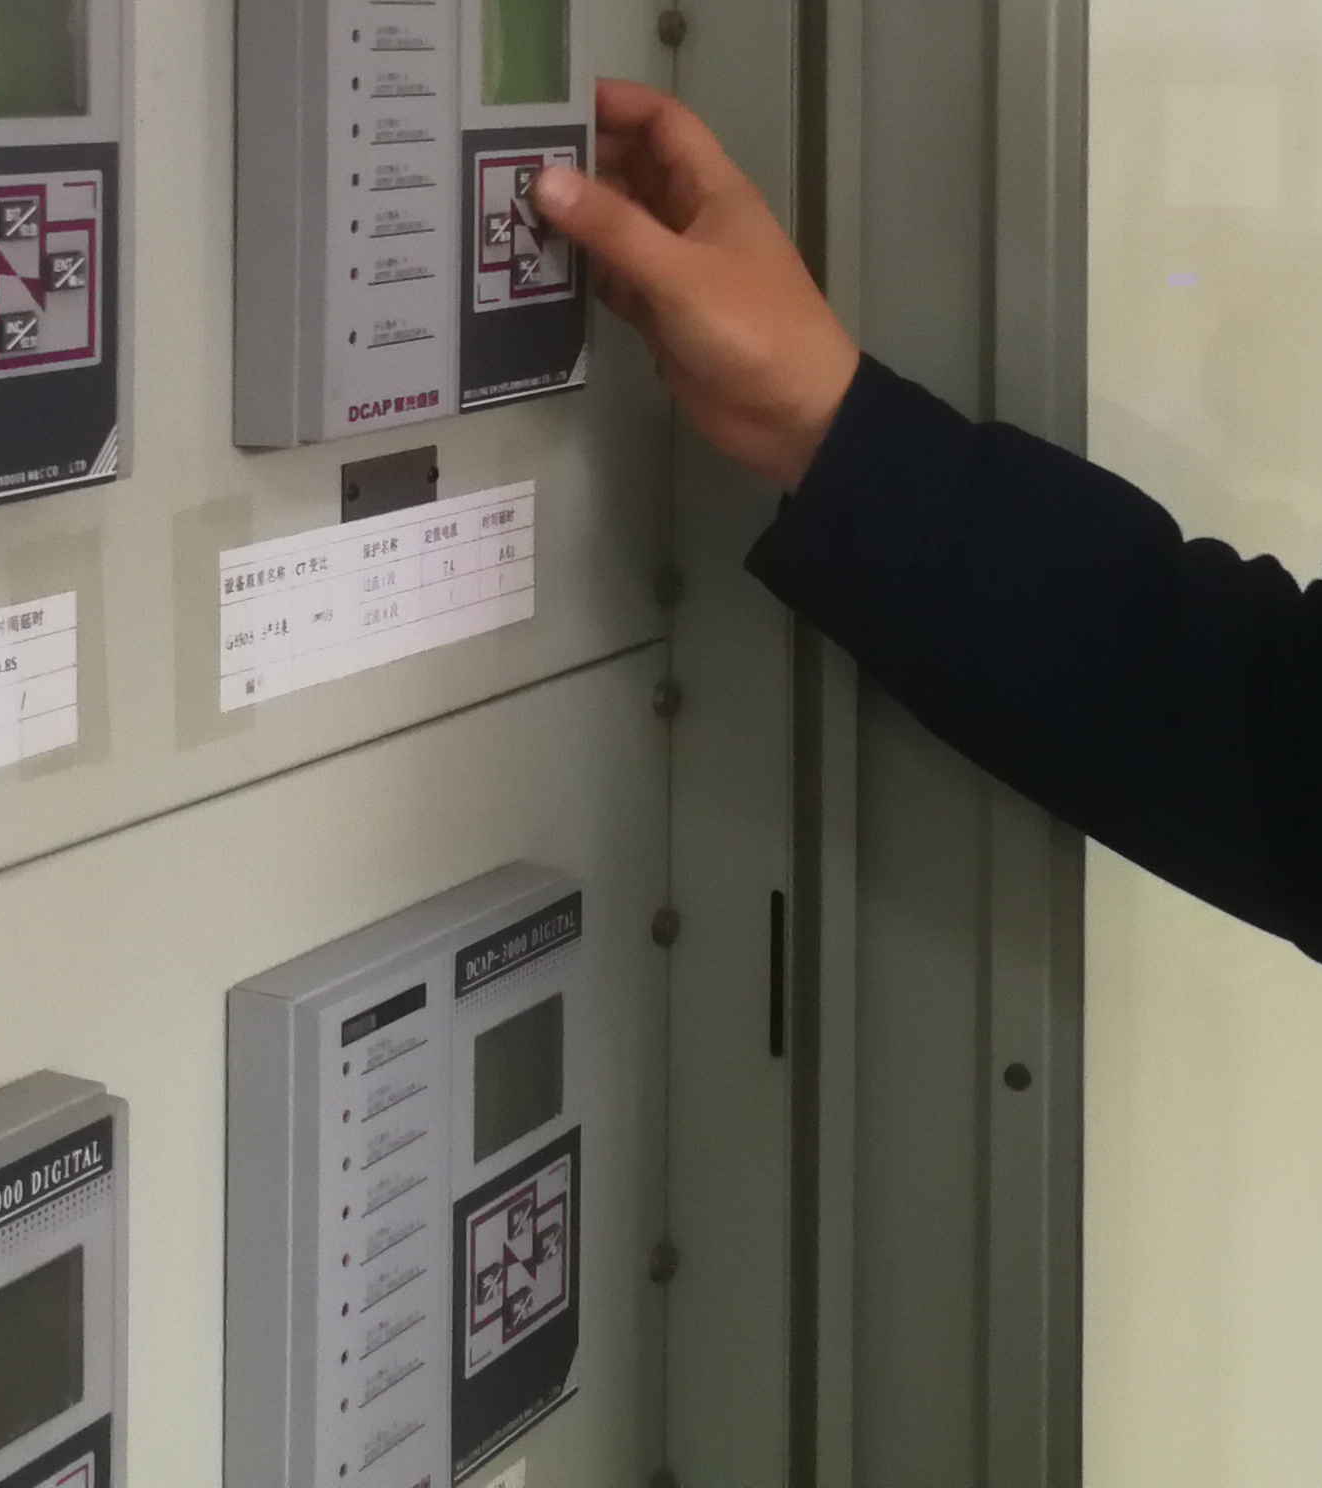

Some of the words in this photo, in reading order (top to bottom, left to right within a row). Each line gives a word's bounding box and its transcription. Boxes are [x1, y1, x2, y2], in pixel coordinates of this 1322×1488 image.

[465, 933, 528, 982] DCAP-3000
[531, 909, 577, 951] DIGITAL
[30, 1141, 102, 1194] DIGITAL
